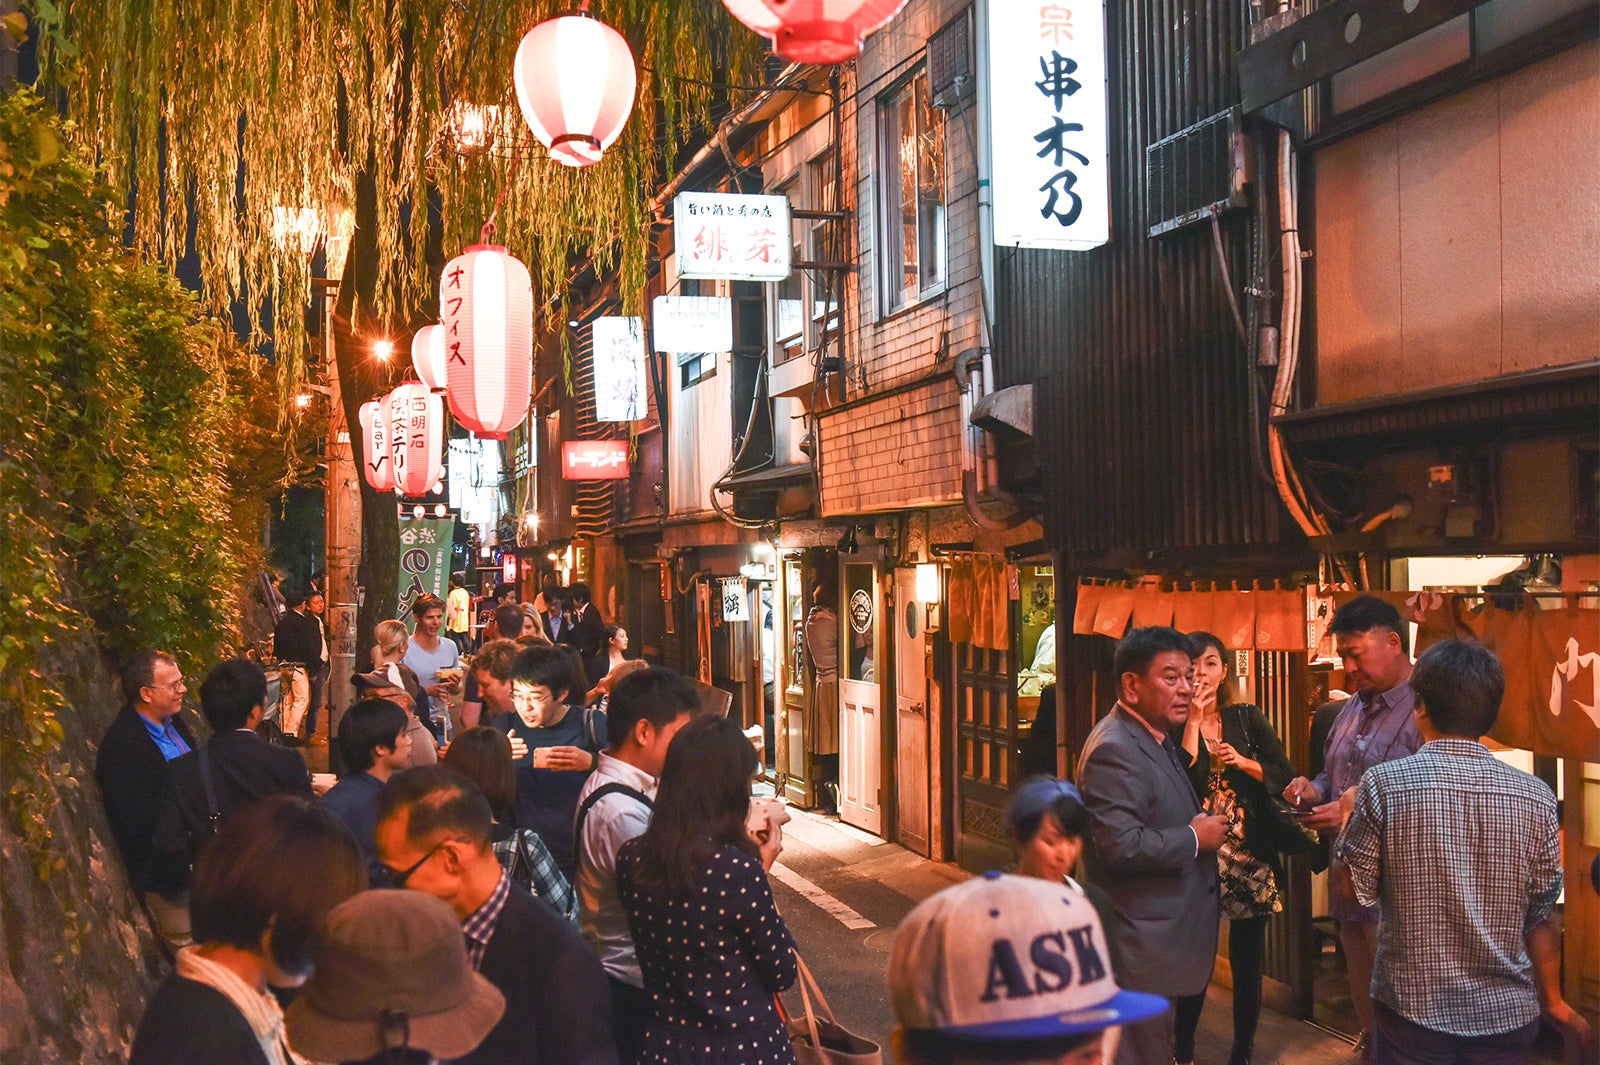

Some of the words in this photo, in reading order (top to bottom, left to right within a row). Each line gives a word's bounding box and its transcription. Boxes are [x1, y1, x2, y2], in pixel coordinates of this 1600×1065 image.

[1033, 49, 1090, 227] 串木乃
[446, 265, 466, 366] オフィス
[410, 397, 426, 449] 西明石
[979, 924, 1107, 1003] ASK
